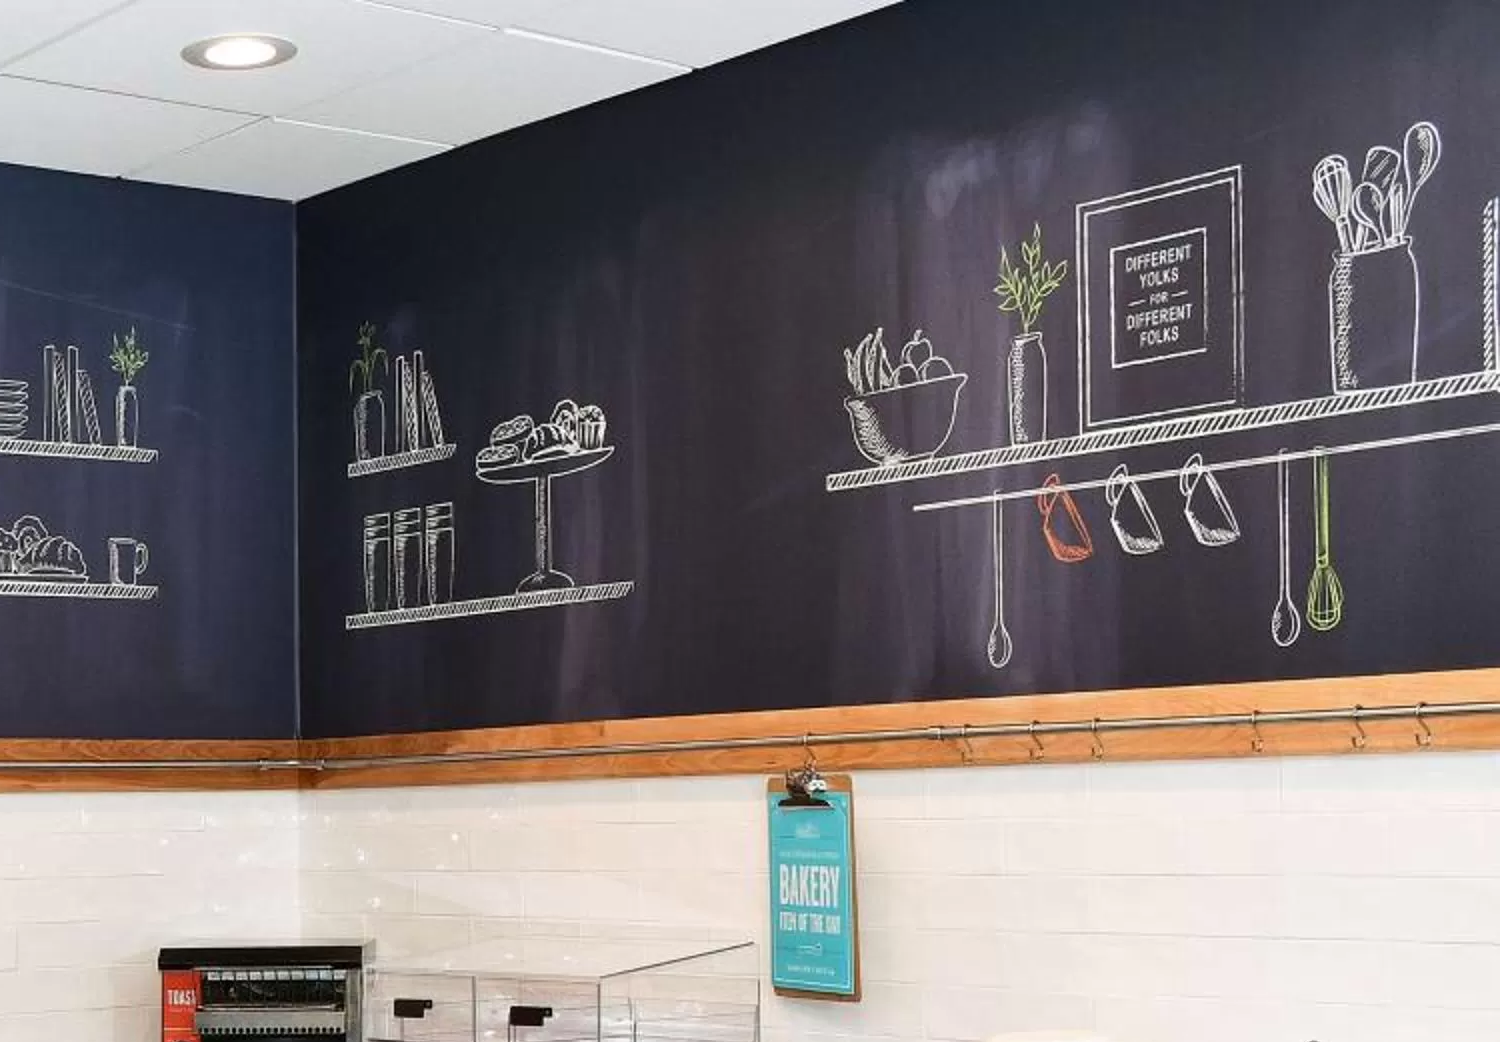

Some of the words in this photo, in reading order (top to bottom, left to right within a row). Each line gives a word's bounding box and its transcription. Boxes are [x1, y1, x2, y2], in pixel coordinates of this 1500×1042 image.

[1125, 243, 1192, 273] DIFFERENT
[1139, 267, 1179, 289] YOLKS
[1149, 291, 1169, 305] FOR
[1126, 303, 1192, 331] DIFFERENT
[1140, 325, 1179, 347] FOLKS
[780, 864, 840, 908] BAKERY
